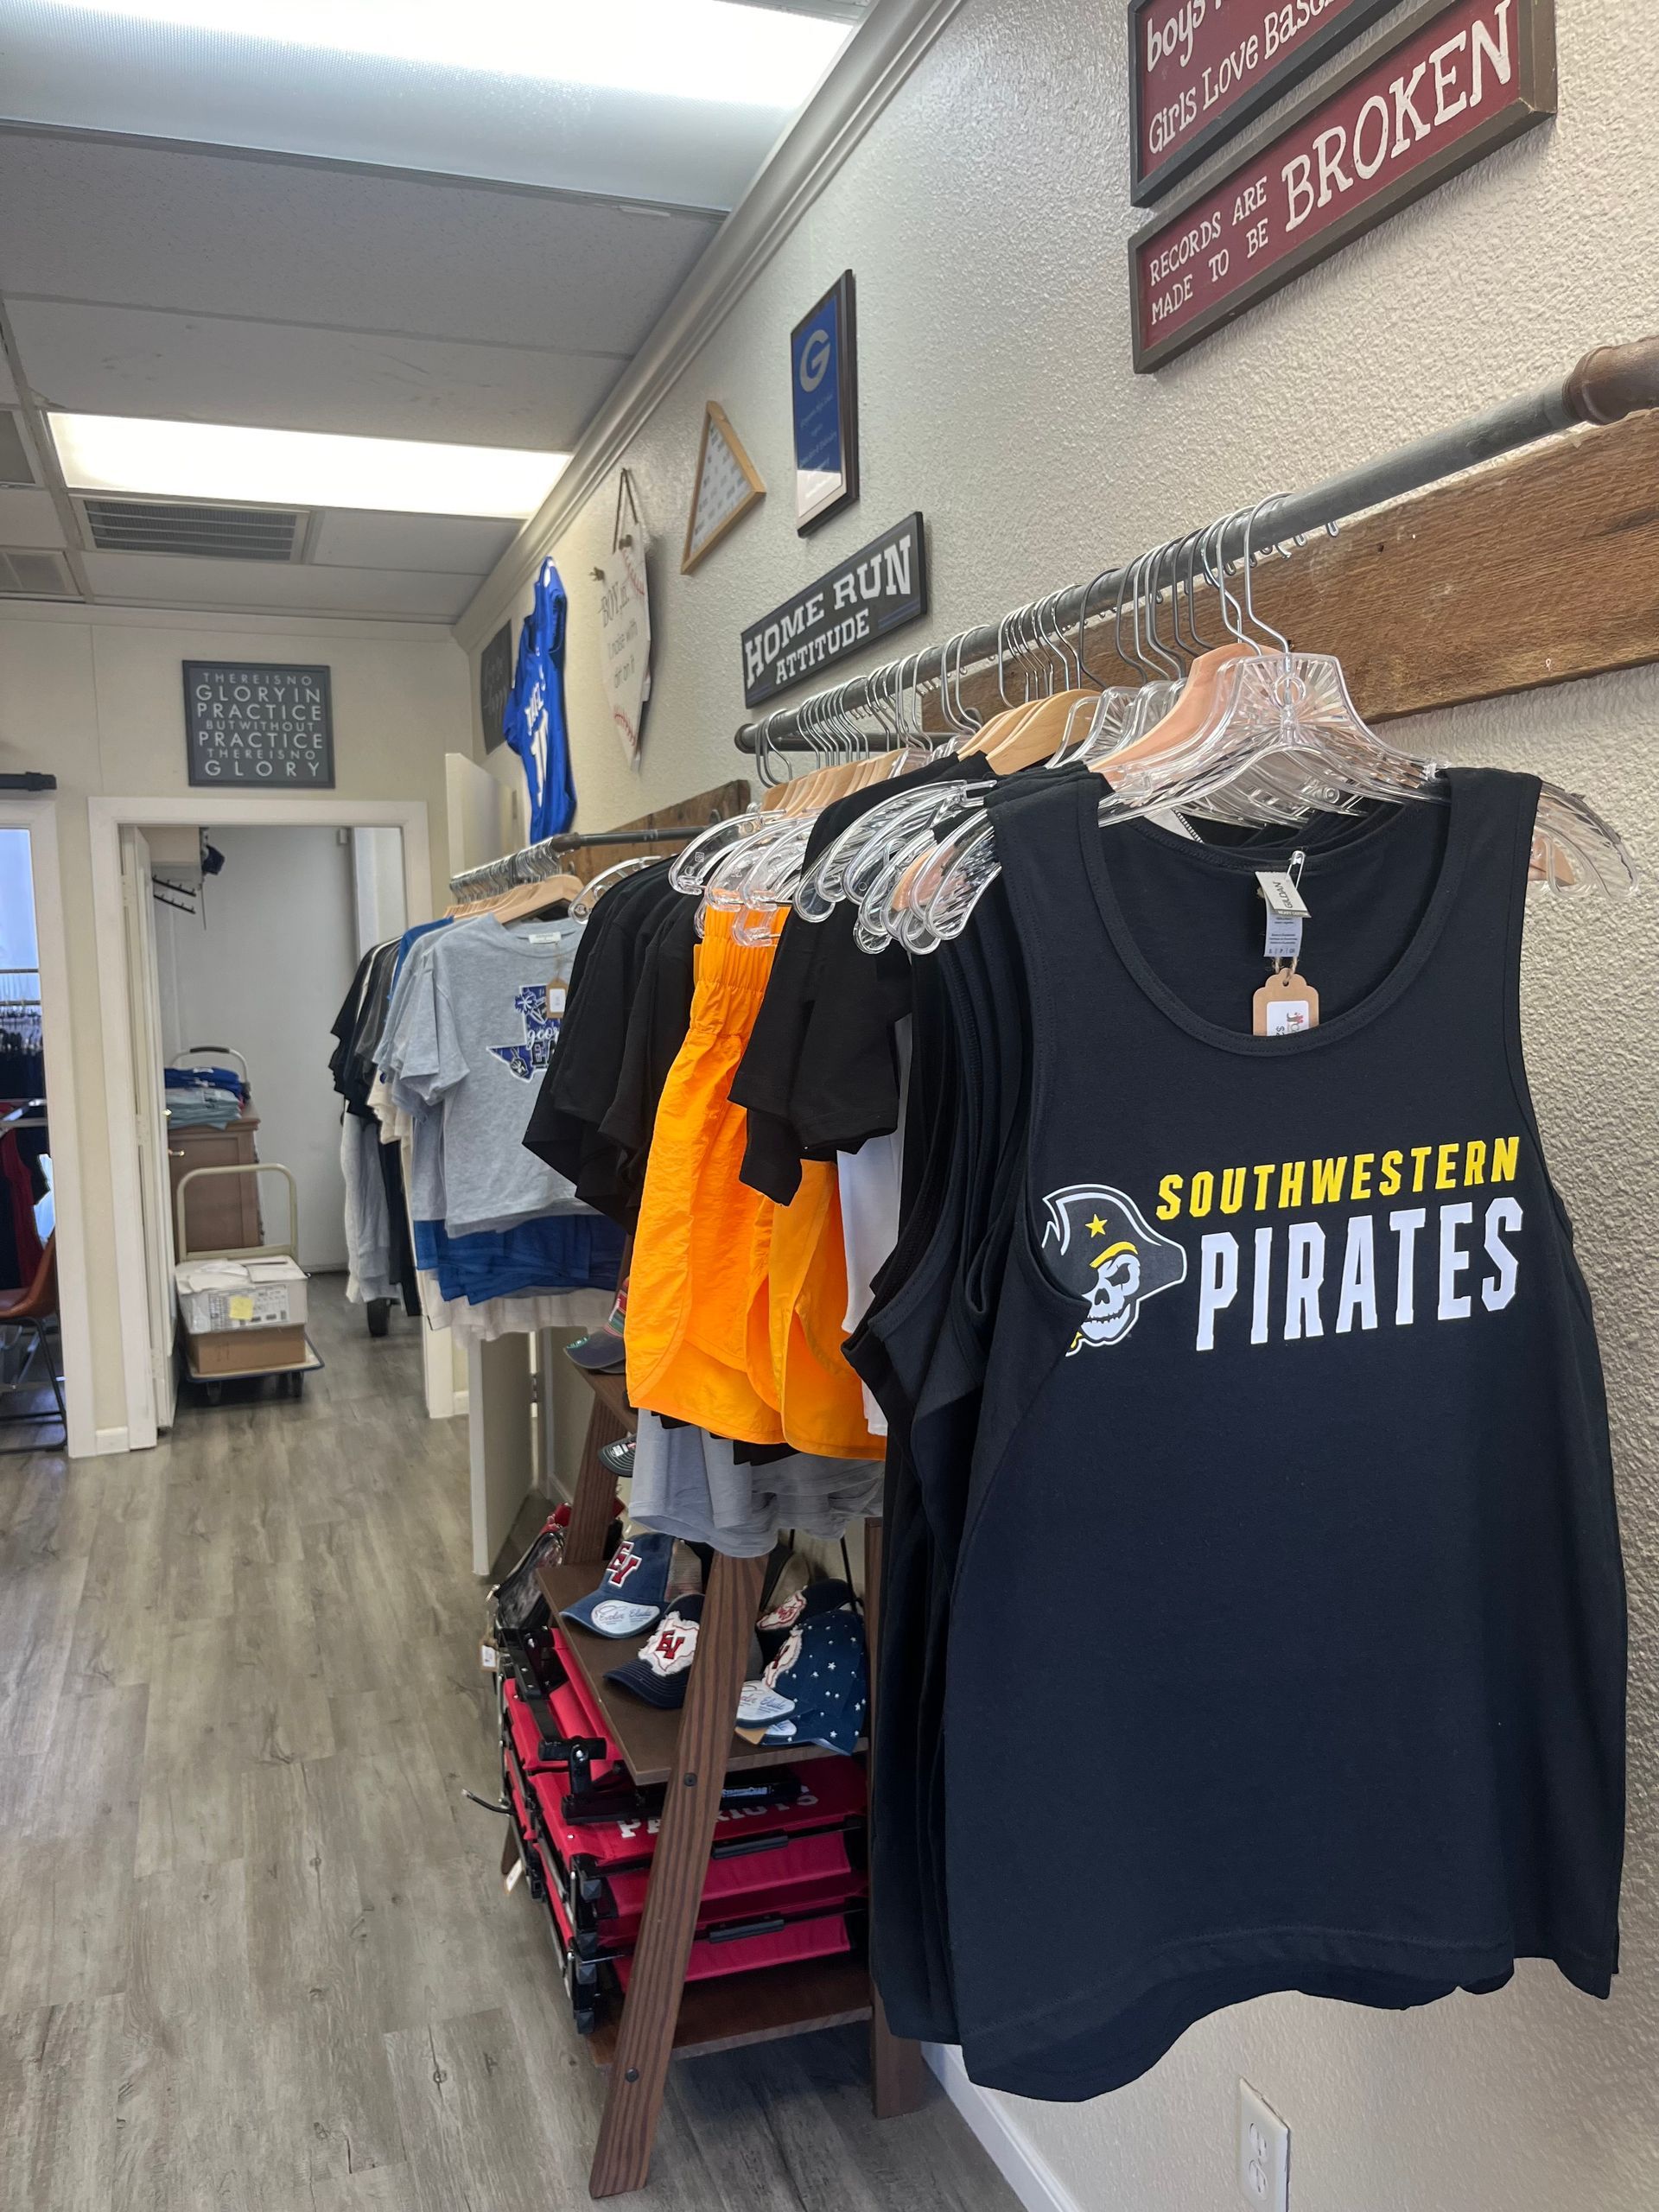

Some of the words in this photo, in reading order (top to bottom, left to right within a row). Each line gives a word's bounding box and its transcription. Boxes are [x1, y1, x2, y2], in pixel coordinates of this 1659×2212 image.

[1147, 0, 1206, 72] boys
[1148, 86, 1197, 154] Girls
[1201, 35, 1259, 111] Love
[1281, 0, 1511, 232] BROKEN
[1149, 211, 1222, 287] RECORDS
[1231, 175, 1268, 226] ARE
[1151, 273, 1193, 325] MADE
[1208, 248, 1230, 283] TO
[1245, 217, 1268, 258] BE
[745, 593, 824, 690] HOME
[833, 534, 911, 610] RUN
[776, 608, 870, 684] ATTITUDE
[196, 684, 285, 702] GLORY
[295, 688, 321, 702] IN
[203, 672, 260, 684] THERE
[287, 676, 312, 686] NO
[197, 702, 321, 721] PRACTICE
[206, 720, 236, 730] BUT
[239, 721, 314, 732] WITHOUT
[199, 731, 323, 748] PRACTICE
[207, 748, 264, 760] THERE
[290, 750, 315, 760] NO
[205, 760, 320, 777] GLORY
[1272, 880, 1294, 909] GILDAN
[1156, 1136, 1520, 1220] SOUTHWESTERN
[1196, 1197, 1522, 1351] PIRATES
[655, 1630, 686, 1660] EV
